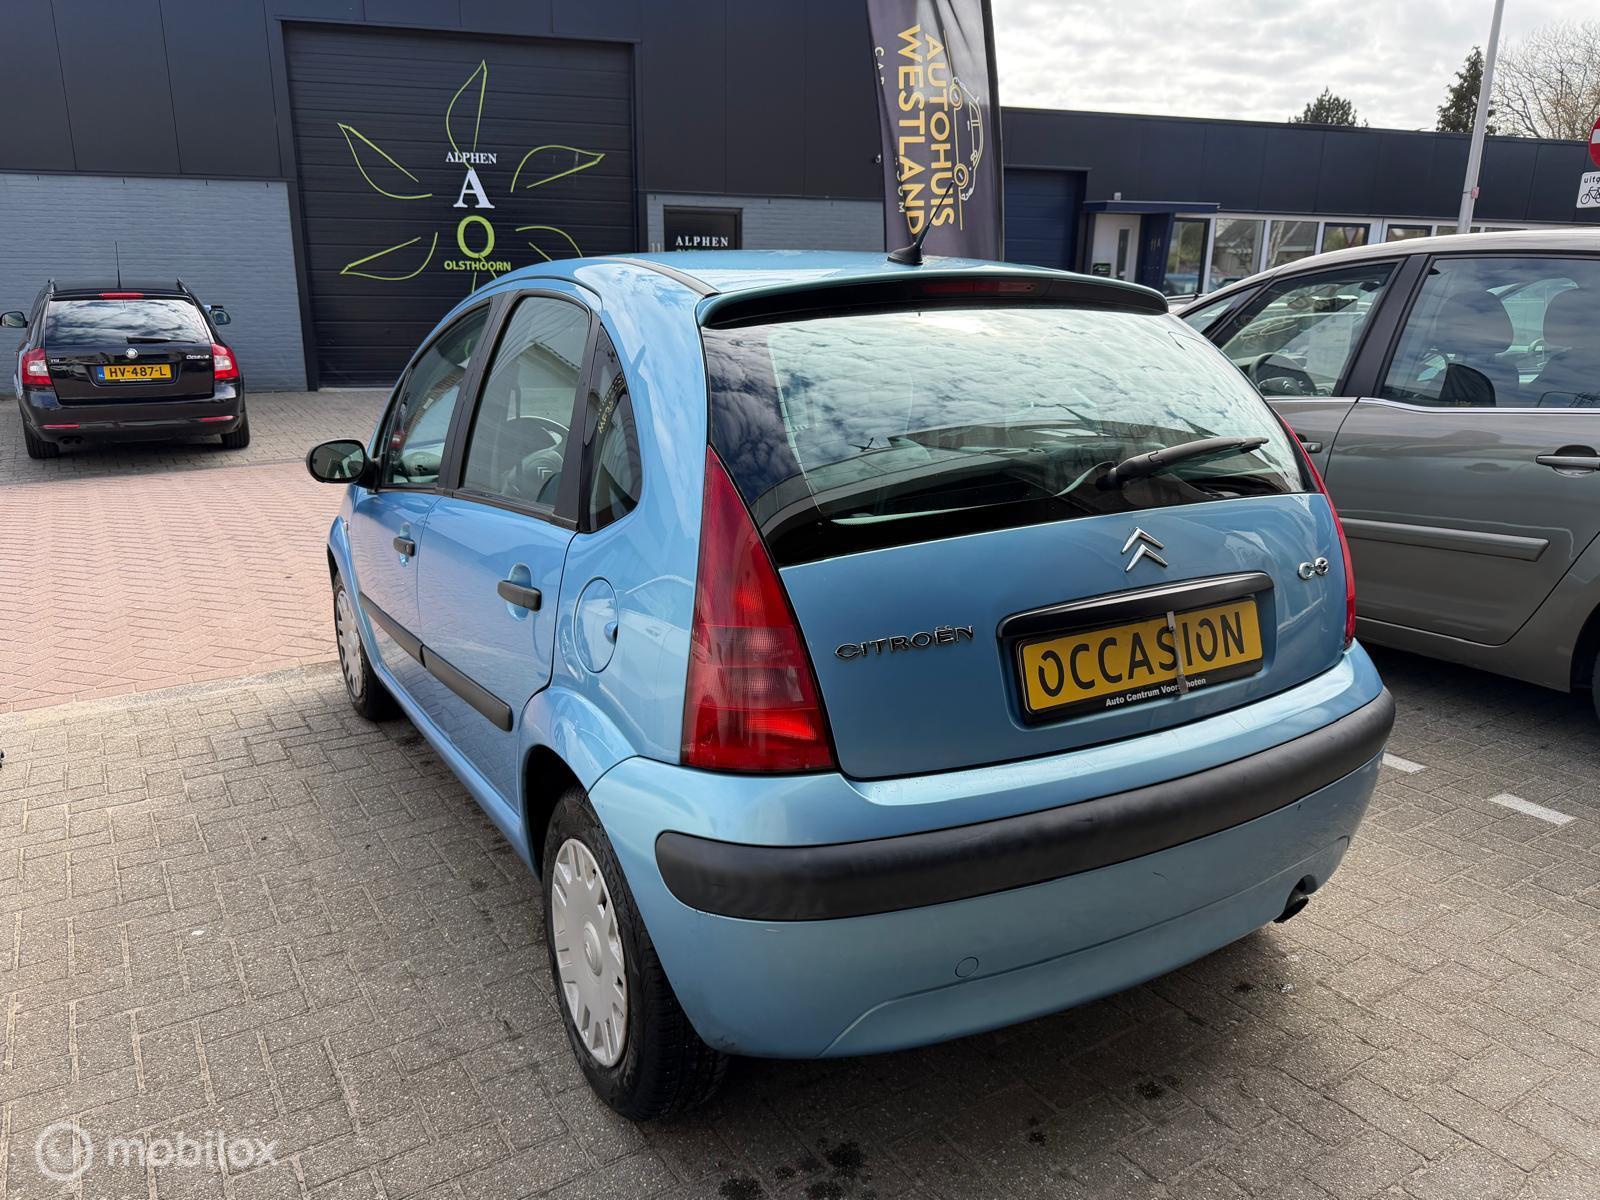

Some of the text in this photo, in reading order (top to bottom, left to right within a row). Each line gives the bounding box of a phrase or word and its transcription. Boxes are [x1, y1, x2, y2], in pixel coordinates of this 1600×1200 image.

[898, 24, 926, 234] WESTLAND
[925, 33, 955, 227] AUTOHUIS
[445, 151, 498, 165] ALPHEN
[453, 167, 496, 209] A
[457, 215, 495, 259] O
[675, 235, 729, 247] ALPHEN
[443, 260, 512, 272] OLSTHOORN
[108, 366, 168, 378] HV-487-L
[834, 624, 974, 660] CITROËN
[1038, 611, 1246, 698] OCCASION
[1105, 677, 1207, 707] Auto Centrum Voorhoten
